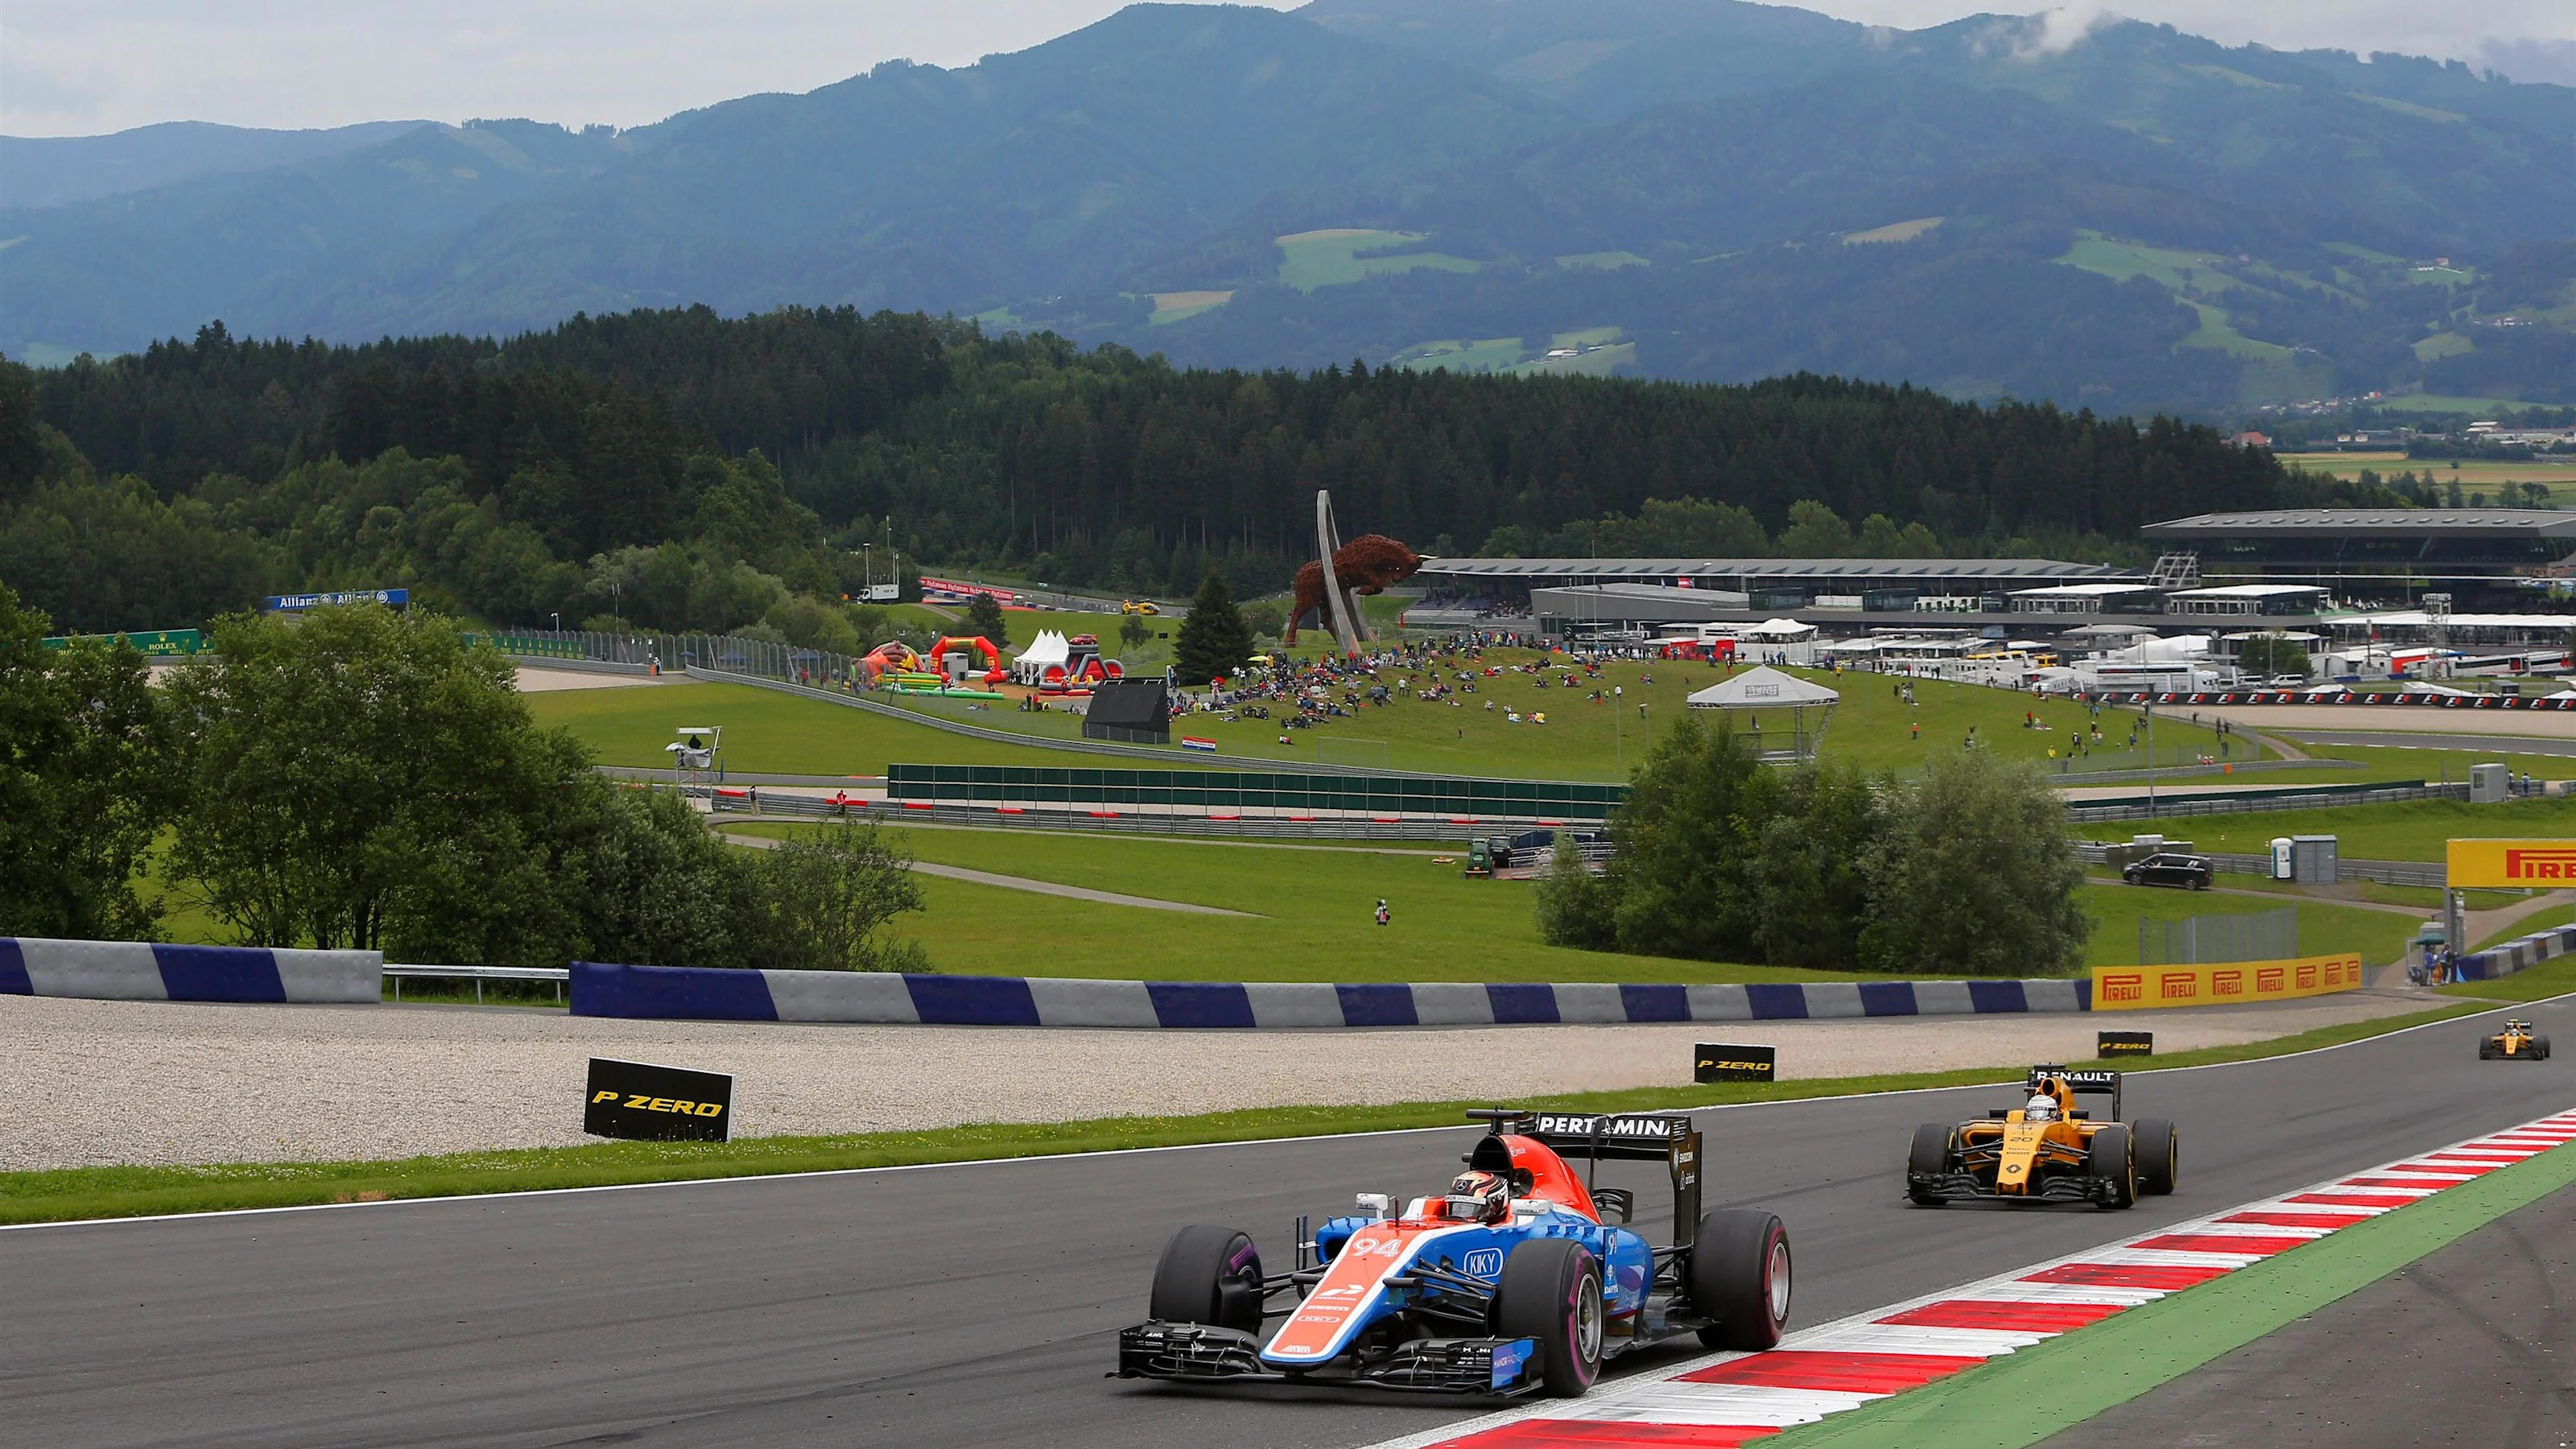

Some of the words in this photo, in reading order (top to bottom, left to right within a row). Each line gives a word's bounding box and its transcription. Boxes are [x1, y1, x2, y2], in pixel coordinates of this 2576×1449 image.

[149, 642, 177, 650] ROLEX
[2103, 974, 2141, 1001] PIRELLI
[2161, 972, 2196, 998] PIRELLI
[2212, 971, 2242, 995] PIRELLI
[2257, 968, 2284, 992] PIRELLI
[2296, 965, 2317, 989] PIRELLI
[1698, 1060, 1714, 1068] P
[1715, 1061, 1771, 1071] ZERO
[592, 1090, 619, 1104] P
[623, 1094, 723, 1117] ZERO
[1352, 1238, 1403, 1256] 94
[1469, 1253, 1495, 1274] KIKY
